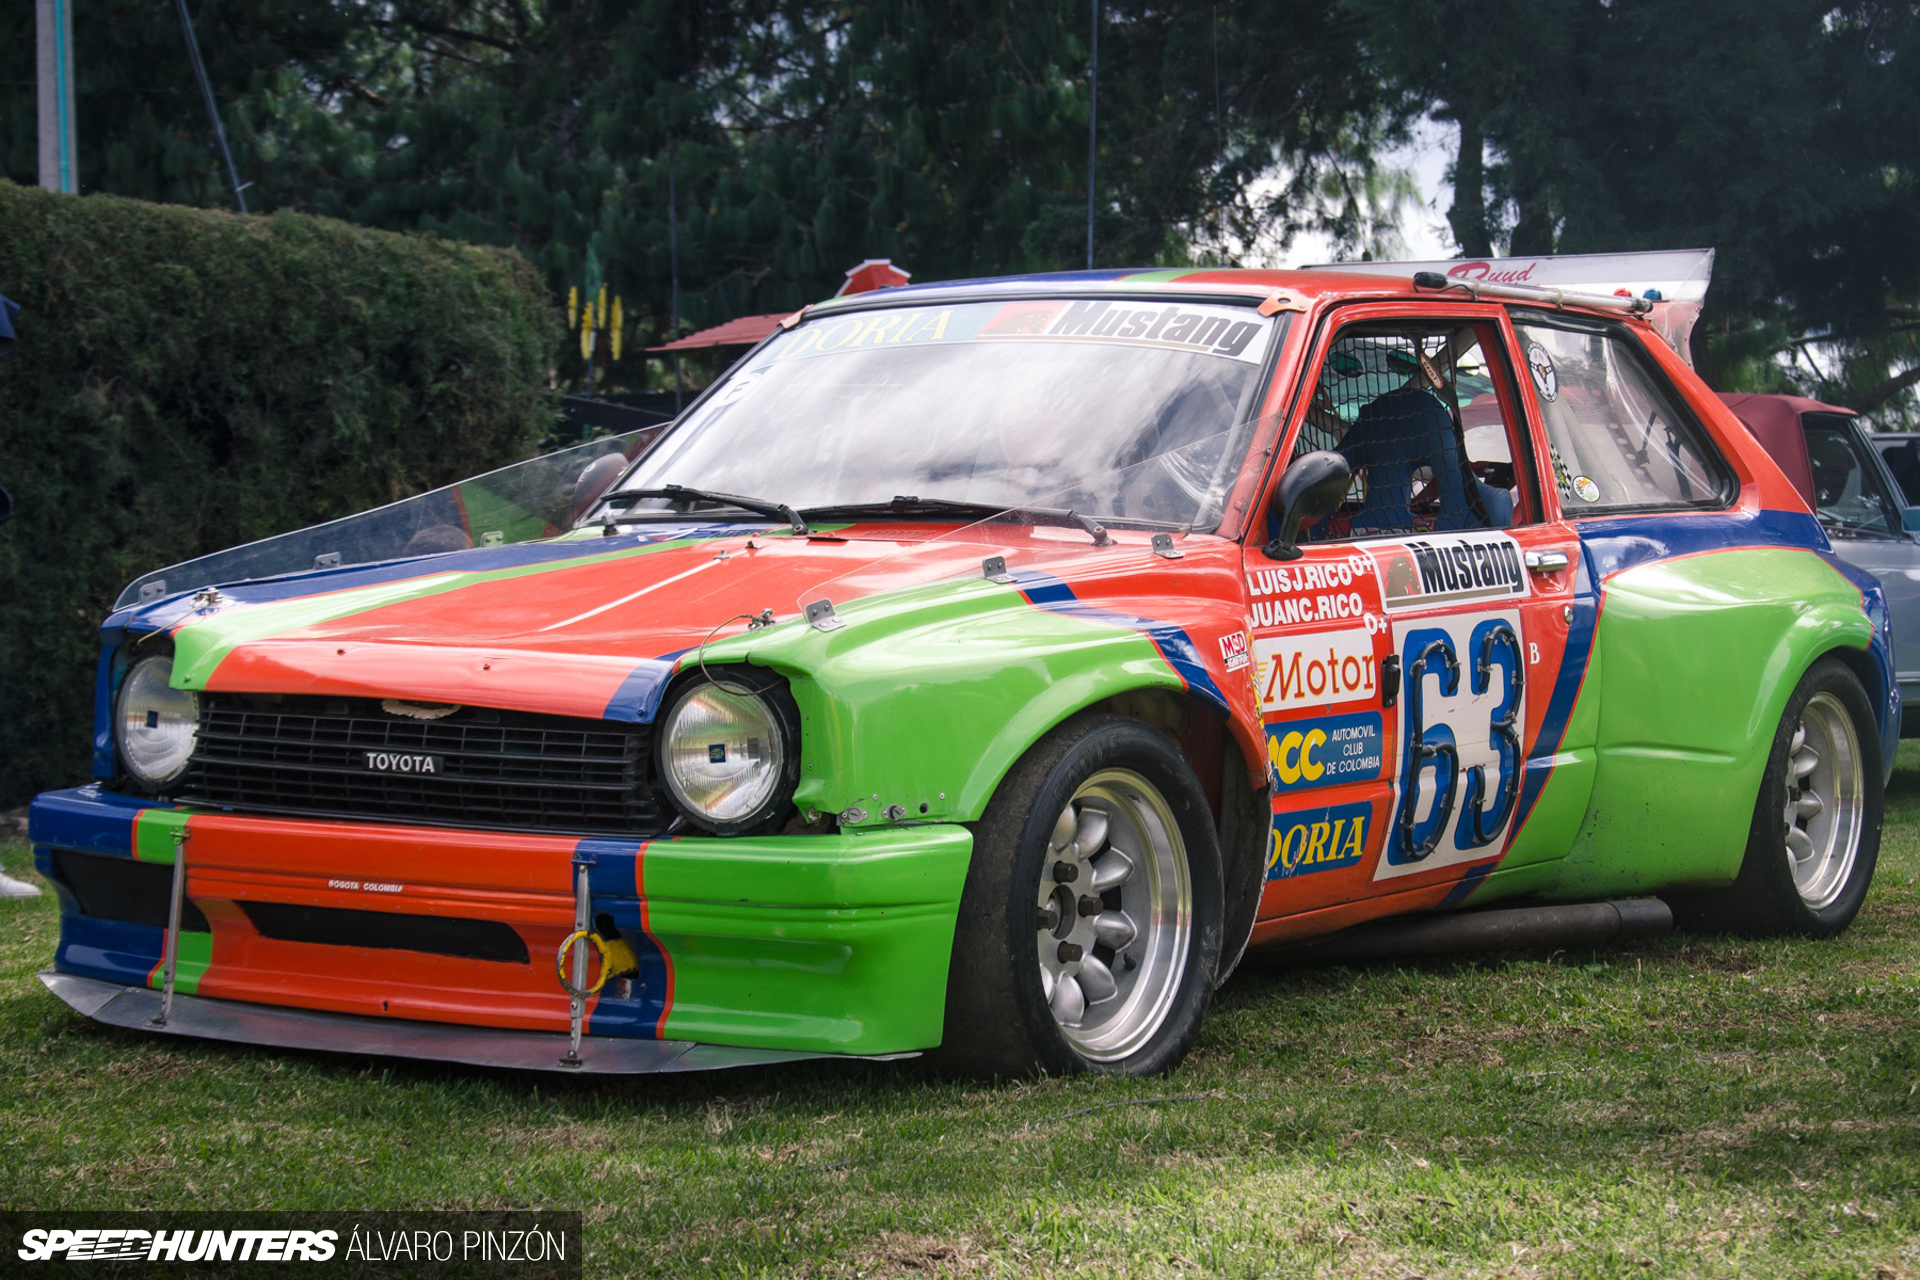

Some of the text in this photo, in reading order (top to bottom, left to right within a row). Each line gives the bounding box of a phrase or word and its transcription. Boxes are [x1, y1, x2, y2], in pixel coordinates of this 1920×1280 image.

[772, 309, 954, 361] DORIA
[1048, 301, 1263, 357] Mustang
[1404, 540, 1524, 594] Mustang
[1221, 633, 1247, 658] MSD
[1529, 641, 1541, 665] B
[1263, 647, 1374, 704] Motor
[1331, 724, 1376, 742] AUTOMOVIL
[1387, 618, 1524, 867] 63
[1342, 741, 1364, 757] CLUB
[366, 753, 435, 774] TOYOTA
[1326, 755, 1380, 776] DE COLOMBIA
[327, 879, 404, 894] BOGOTA COLOMBIA
